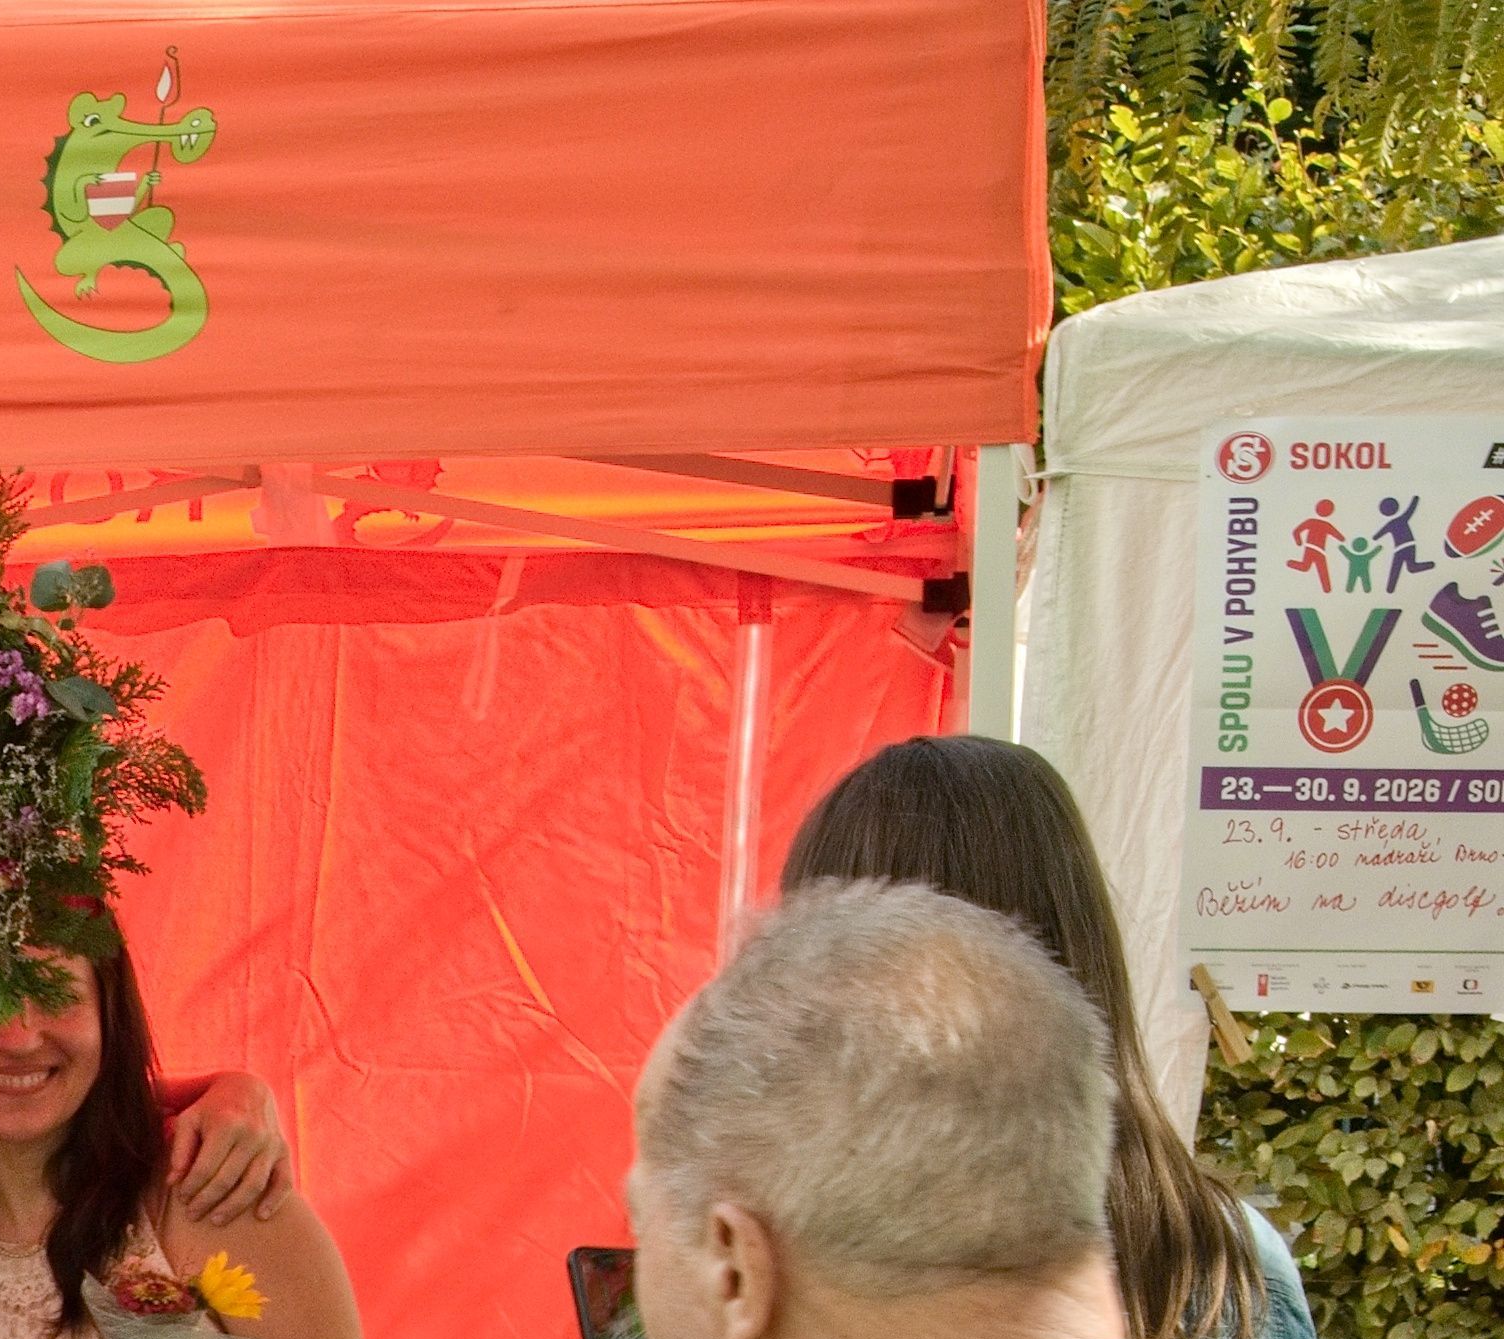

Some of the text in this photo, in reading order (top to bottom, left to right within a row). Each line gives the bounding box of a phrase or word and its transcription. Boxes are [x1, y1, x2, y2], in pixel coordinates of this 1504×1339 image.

[1289, 441, 1393, 470] SOKOL
[1218, 496, 1260, 753] SPOLU V POHYBU
[1343, 777, 1367, 802] 9.
[1374, 778, 1441, 803] 2026
[1447, 778, 1462, 803] /
[1468, 779, 1504, 803] SO
[1284, 850, 1339, 869] 16:00
[1312, 892, 1357, 912] na
